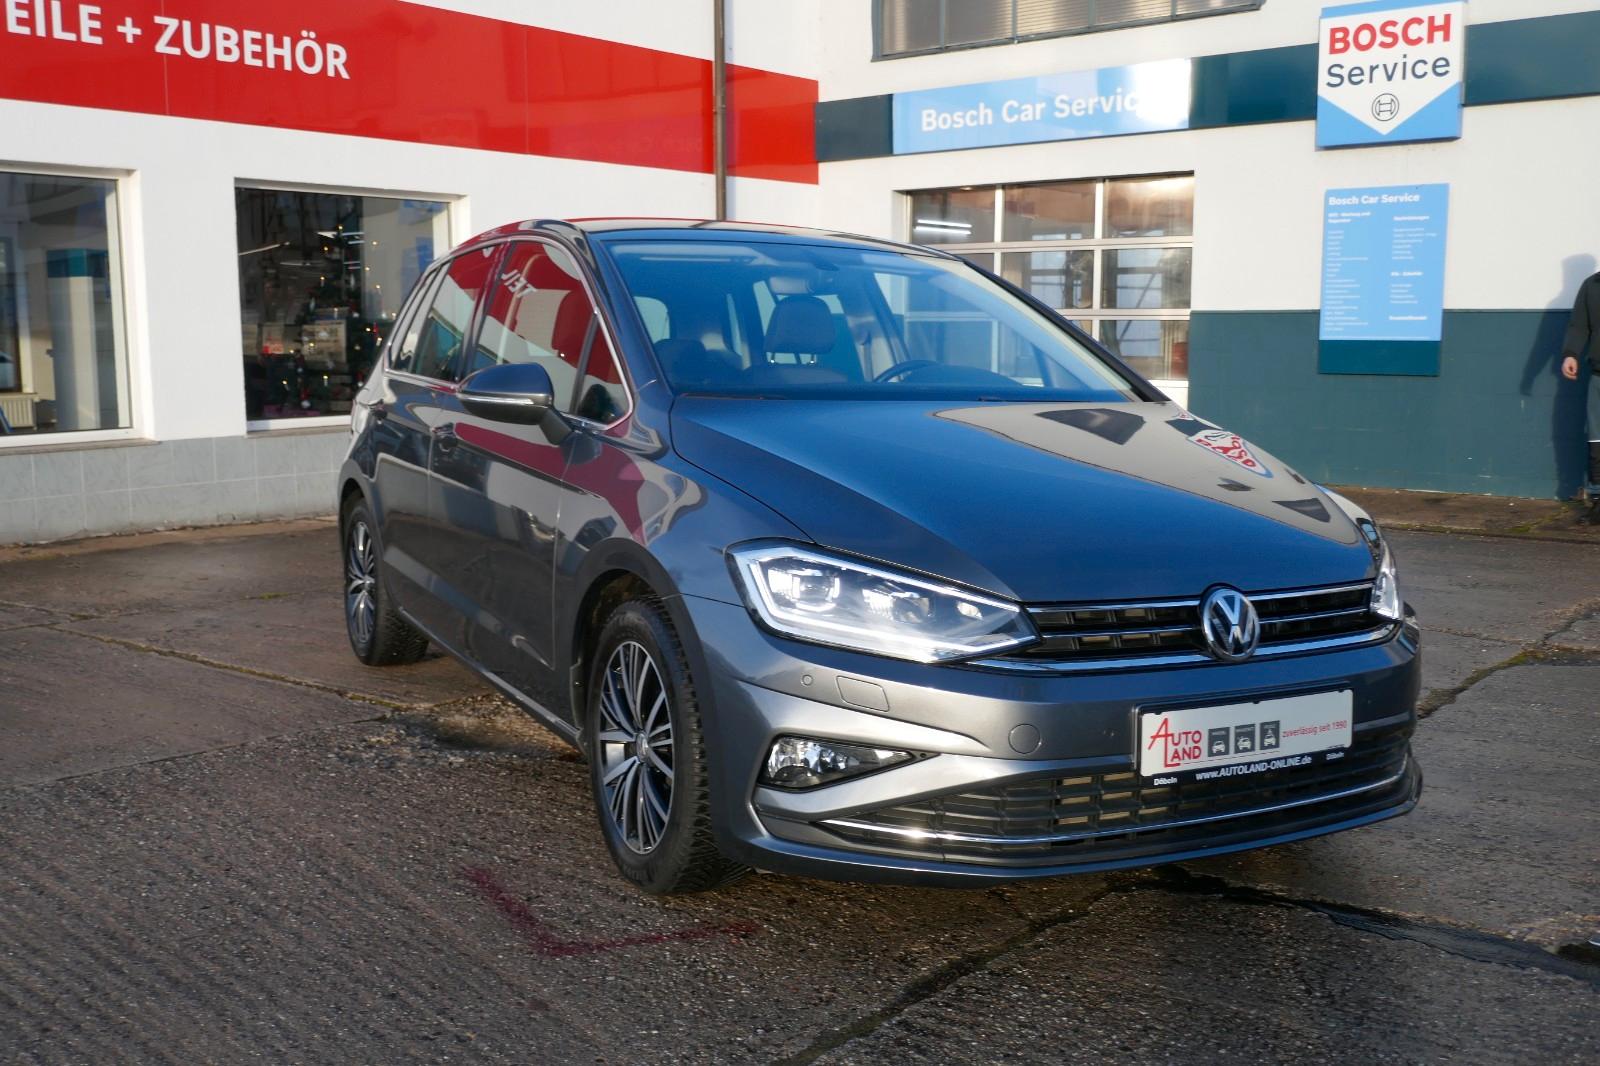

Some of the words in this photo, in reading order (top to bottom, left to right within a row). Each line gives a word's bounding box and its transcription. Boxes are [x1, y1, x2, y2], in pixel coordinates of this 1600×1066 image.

[5, 0, 103, 45] EILE
[153, 15, 350, 79] ZUBEHÖR
[1328, 13, 1452, 54] BOSCH
[1326, 54, 1450, 88] Service
[921, 102, 993, 132] Bosch
[1002, 99, 1046, 124] Car
[1053, 87, 1140, 119] Servic
[1328, 196, 1359, 206] Bosch
[1361, 195, 1379, 204] Car
[1381, 192, 1420, 203] Service
[1148, 717, 1202, 750] AUTO
[1164, 744, 1202, 768] LAND
[1195, 755, 1312, 781] www.AUTOLAND-ONLINE.de
